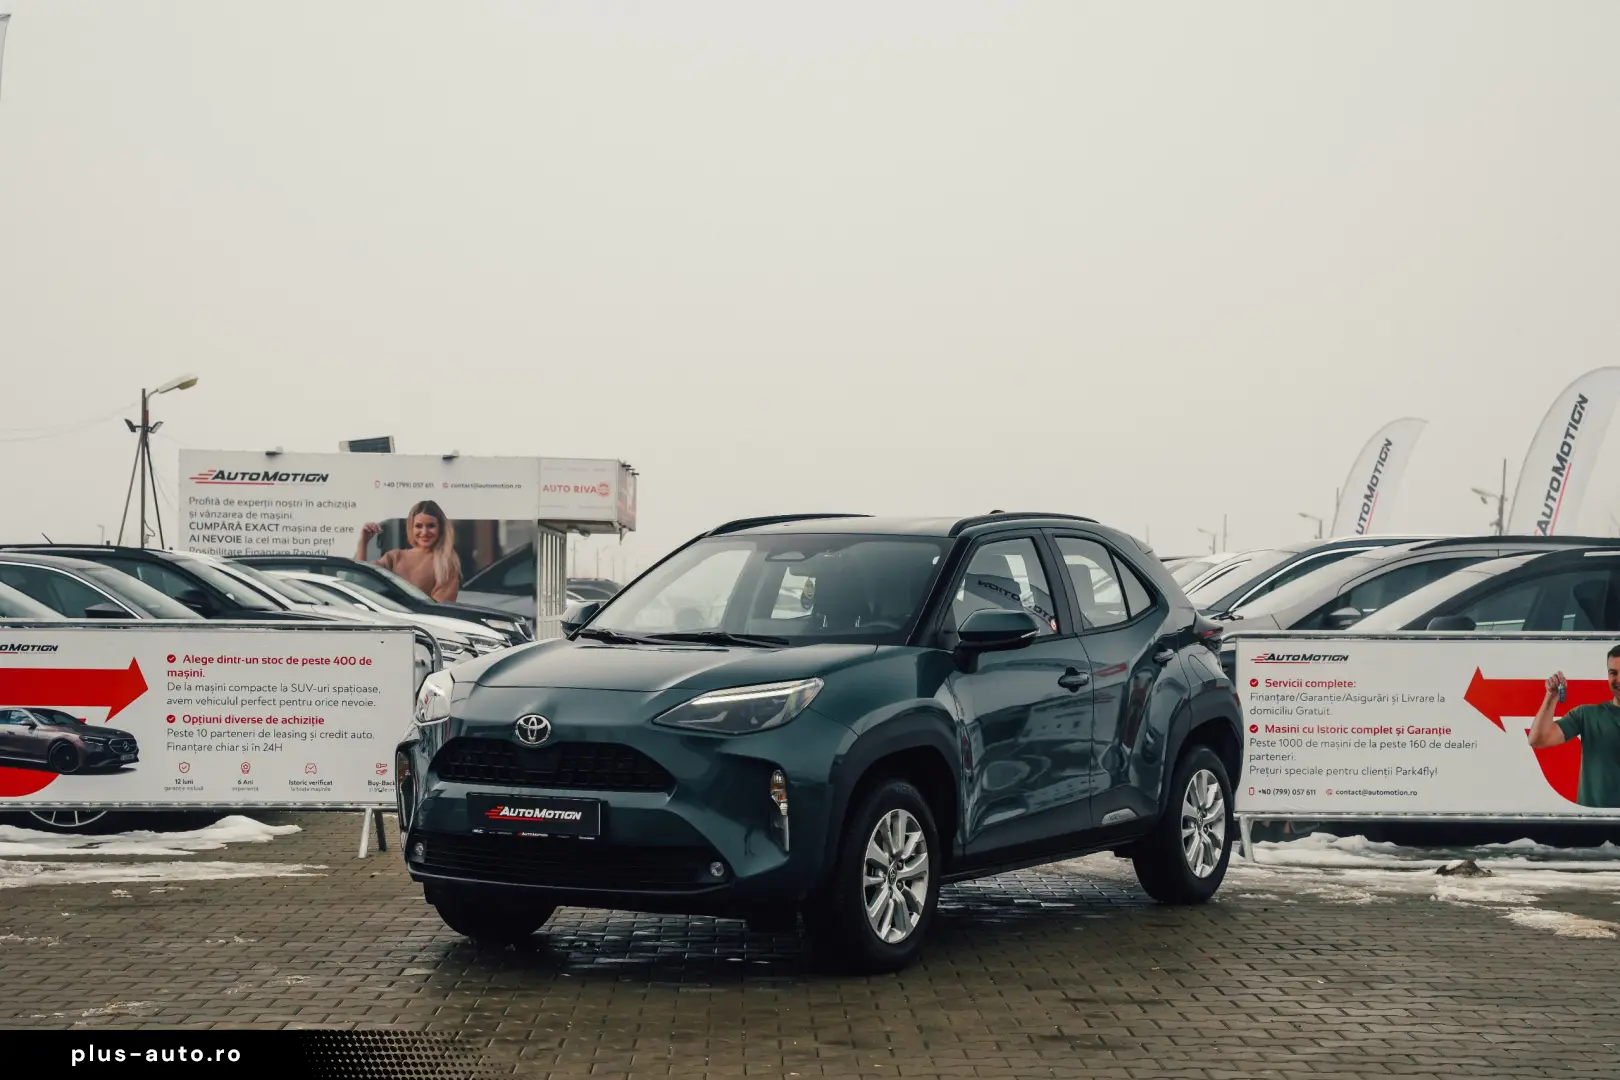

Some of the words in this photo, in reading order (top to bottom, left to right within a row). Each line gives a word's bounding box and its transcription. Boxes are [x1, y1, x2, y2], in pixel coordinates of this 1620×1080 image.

[543, 484, 571, 493] AUTO
[573, 485, 597, 494] RIVA
[1355, 438, 1393, 535] UTOMOTION
[189, 497, 221, 506] Profită
[223, 498, 234, 507] de
[237, 499, 273, 510] experții
[275, 499, 303, 510] noștri
[305, 499, 314, 508] în
[316, 499, 357, 511] achiziția
[189, 510, 197, 519] și
[200, 510, 243, 519] vânzarea
[245, 511, 258, 520] de
[189, 520, 242, 531] CUMPĂRĂ
[245, 523, 279, 532] EXACT
[282, 524, 317, 535] mașina
[320, 525, 332, 533] de
[189, 534, 199, 543] AI
[202, 535, 242, 543] NEVOIE
[244, 536, 253, 544] la
[256, 536, 269, 544] cel
[272, 536, 289, 544] mai
[292, 537, 310, 545] bun
[0, 643, 58, 652] OMOTION
[183, 655, 214, 666] Alege
[217, 655, 259, 665] dintr-un
[261, 656, 283, 665] stoc
[286, 656, 299, 666] de
[302, 657, 331, 668] peste
[333, 657, 356, 666] 400
[359, 657, 372, 666] de
[167, 669, 205, 679] mașini.
[167, 682, 182, 692] De
[184, 682, 192, 692] la
[195, 683, 226, 695] mașini
[228, 684, 277, 695] compacte
[280, 684, 288, 693] la
[291, 684, 330, 694] SUV-uri
[332, 685, 381, 696] spațioase,
[1265, 678, 1302, 688] Servicii
[1305, 679, 1357, 691] complete:
[195, 697, 238, 707] vehiculul
[240, 698, 276, 709] perfect
[279, 699, 312, 710] pentru
[315, 698, 339, 708] orice
[341, 699, 376, 708] nevoie.
[1392, 694, 1399, 705] și
[1401, 694, 1435, 703] Livrare
[1437, 694, 1446, 703] la
[1250, 706, 1293, 716] domiciliu
[182, 714, 222, 726] Opțiuni
[225, 715, 263, 725] diverse
[266, 716, 279, 725] de
[281, 716, 325, 727] achiziție
[167, 729, 194, 738] Peste
[197, 729, 208, 738] 10
[210, 729, 255, 741] parteneri
[258, 730, 271, 739] de
[273, 730, 307, 741] leasing
[310, 730, 317, 740] și
[319, 730, 348, 740] credit
[350, 731, 375, 740] auto.
[1302, 726, 1314, 735] cu
[1317, 725, 1349, 735] Istoric
[1351, 725, 1393, 737] complet
[1395, 725, 1404, 737] și
[1407, 726, 1452, 737] Garanție
[166, 743, 213, 754] Finanțare
[215, 743, 239, 752] chiar
[251, 743, 261, 752] în
[263, 743, 283, 752] 24H
[1250, 738, 1276, 748] Peste
[1279, 738, 1303, 748] 1000
[1305, 738, 1318, 748] de
[1321, 739, 1351, 750] mașini
[1354, 739, 1367, 749] de
[1369, 739, 1377, 749] la
[1379, 740, 1407, 751] peste
[1409, 740, 1426, 749] 160
[1428, 740, 1442, 749] de
[1444, 740, 1478, 750] dealeri
[1250, 752, 1296, 763] parteneri.
[1250, 765, 1282, 777] Prețuri
[1284, 766, 1324, 777] speciale
[1326, 767, 1358, 778] pentru
[1361, 766, 1393, 778] clienții
[1395, 767, 1438, 778] Park4fly!
[1273, 788, 1290, 796] (799)
[1335, 789, 1418, 797] contact@automotion.ro
